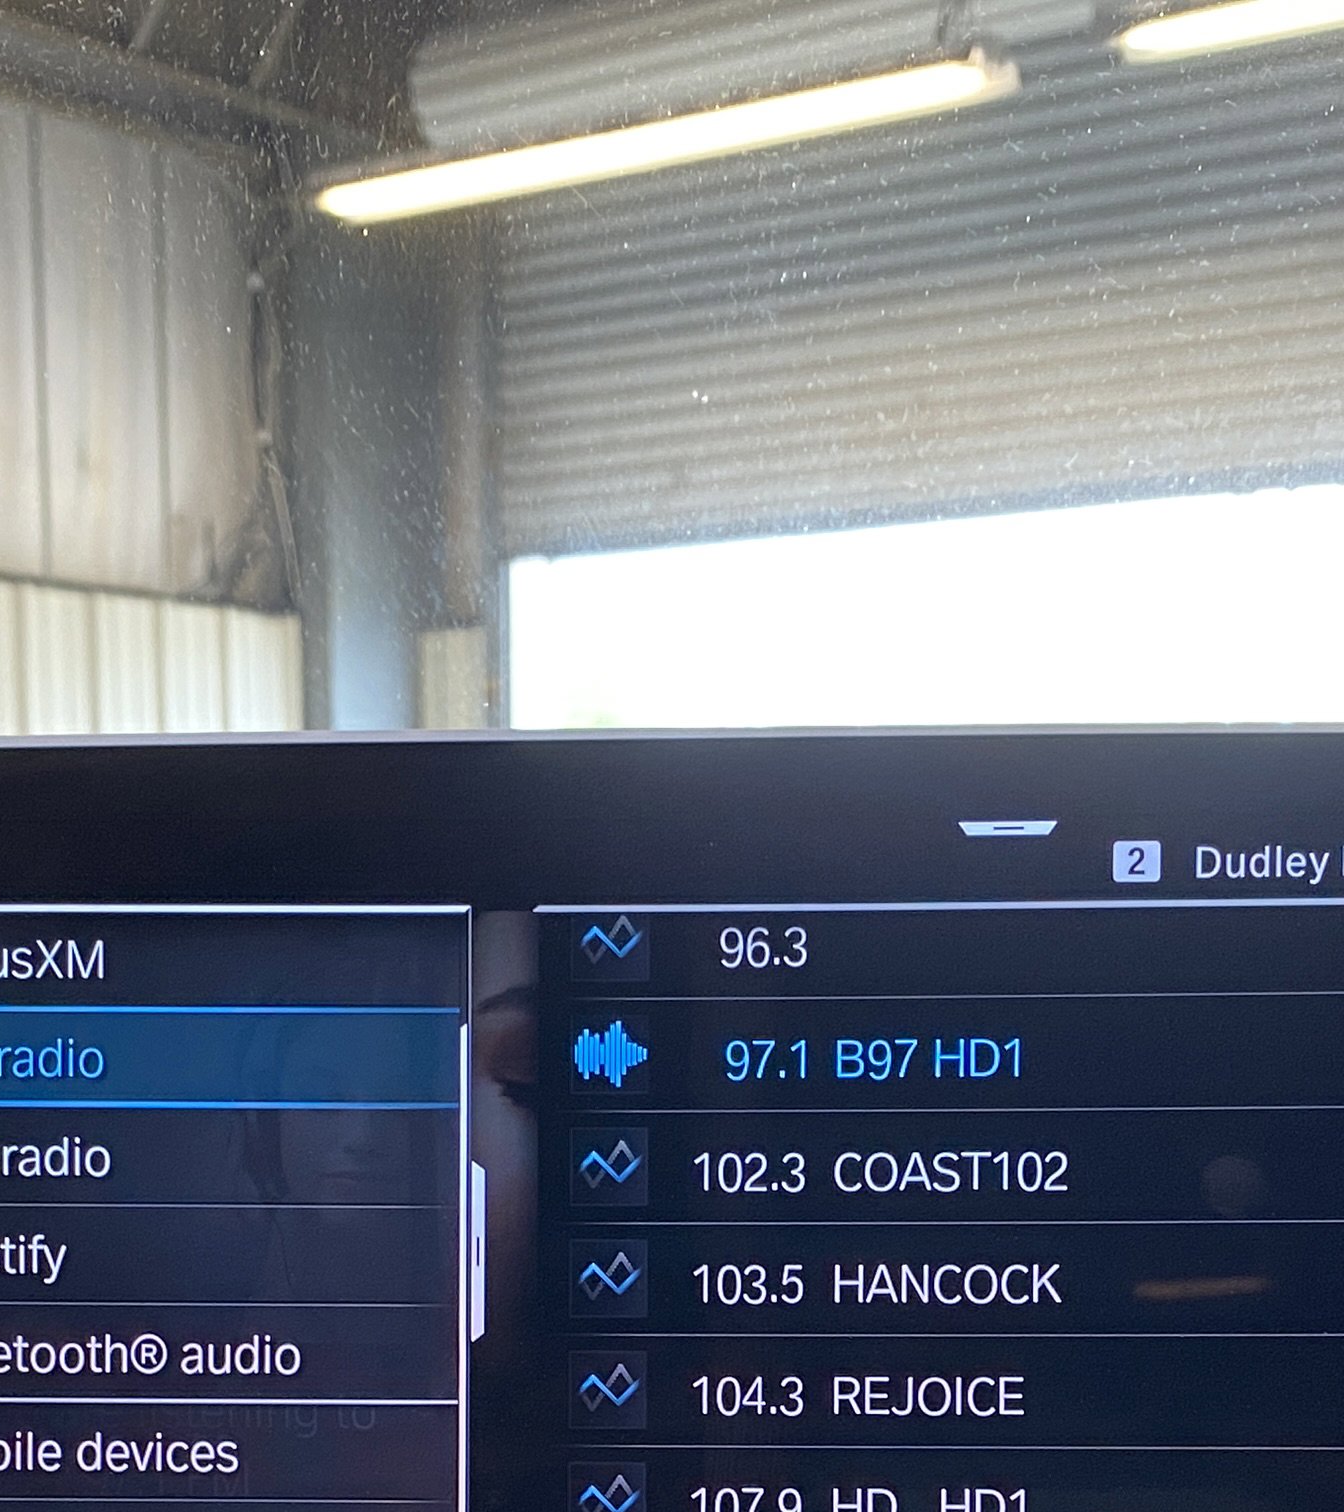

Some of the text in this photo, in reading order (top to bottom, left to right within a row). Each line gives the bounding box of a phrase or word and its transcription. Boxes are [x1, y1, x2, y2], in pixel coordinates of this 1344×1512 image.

[1128, 849, 1147, 876] 2
[1195, 845, 1330, 885] Dudley
[719, 926, 808, 969] 96.3
[725, 1038, 1021, 1082] 97.1 B97 HD1
[2, 1136, 111, 1178] radio
[693, 1151, 1068, 1194] 102.3 COAST102
[692, 1263, 1062, 1305] 103.5 HANCOCK
[180, 1334, 301, 1376] audio
[692, 1375, 1025, 1417] 104.3 REJOICE
[76, 1431, 239, 1473] devices
